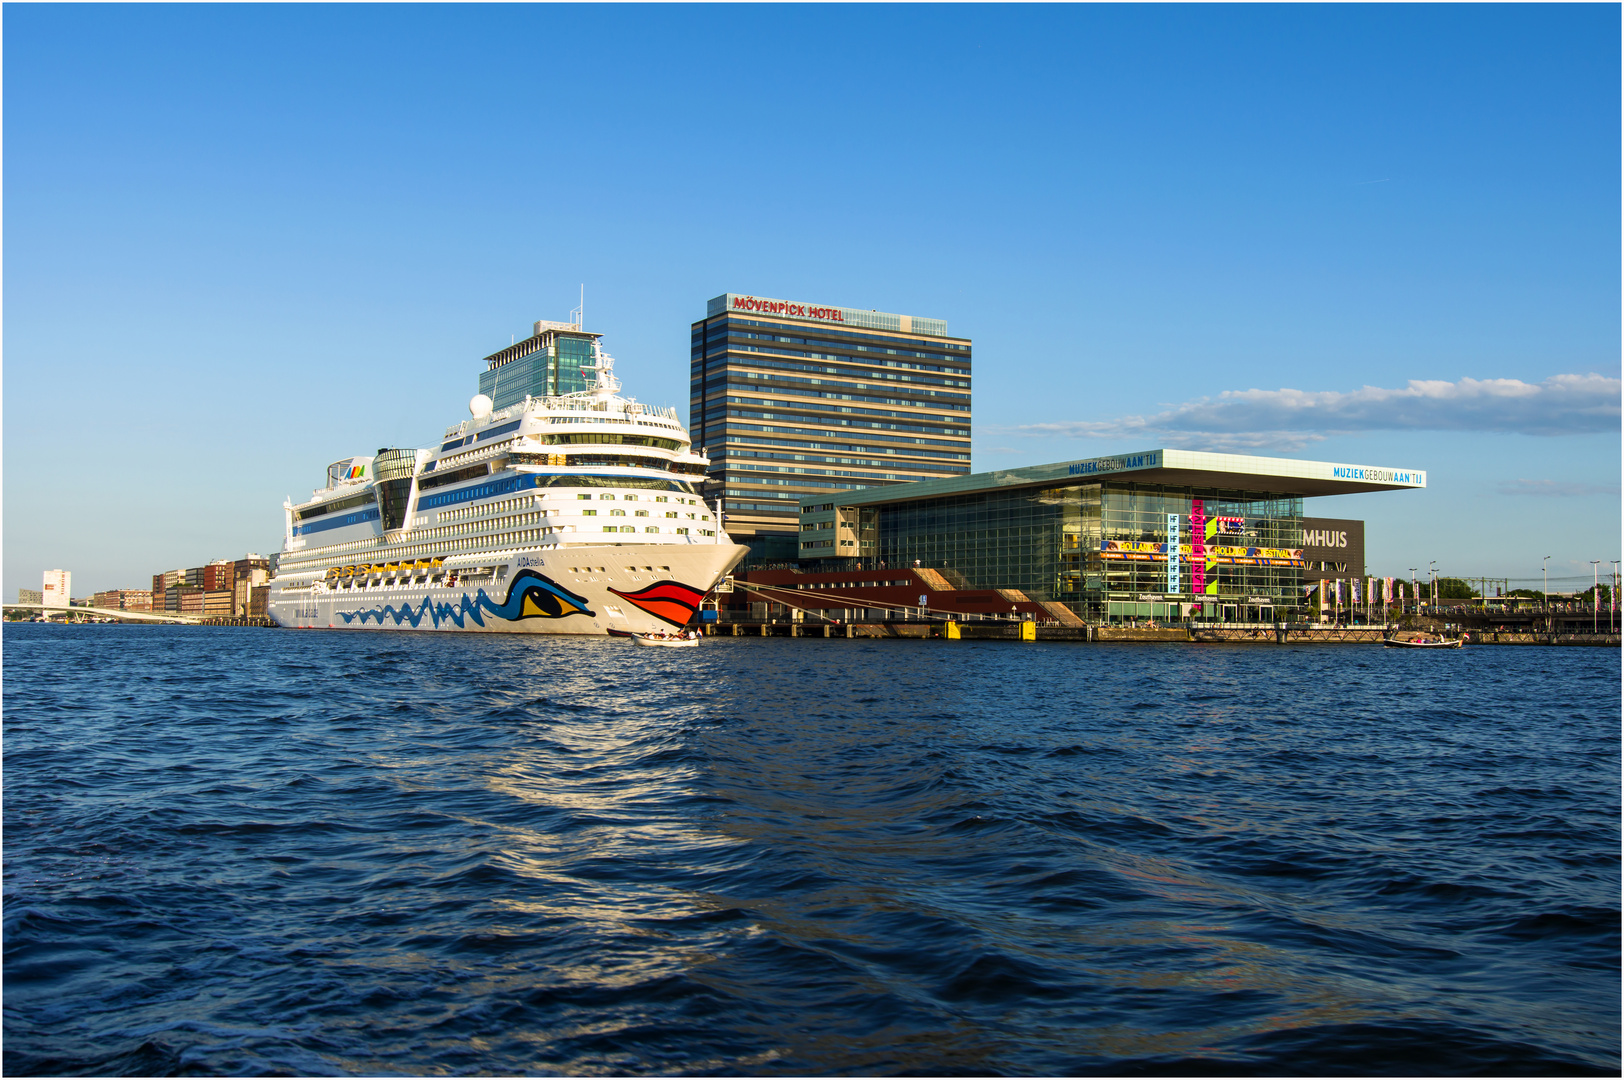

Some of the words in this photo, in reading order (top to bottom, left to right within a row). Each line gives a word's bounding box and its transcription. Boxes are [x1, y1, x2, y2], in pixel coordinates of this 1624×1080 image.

[809, 306, 844, 321] HOTEL
[344, 465, 365, 480] AIDA
[1194, 501, 1202, 553] FESTIVAL
[1120, 542, 1154, 552] HOLLAND
[1215, 546, 1247, 556] HOLLAND
[1261, 549, 1290, 558] FESTIVAL
[517, 556, 544, 567] AIDAstella
